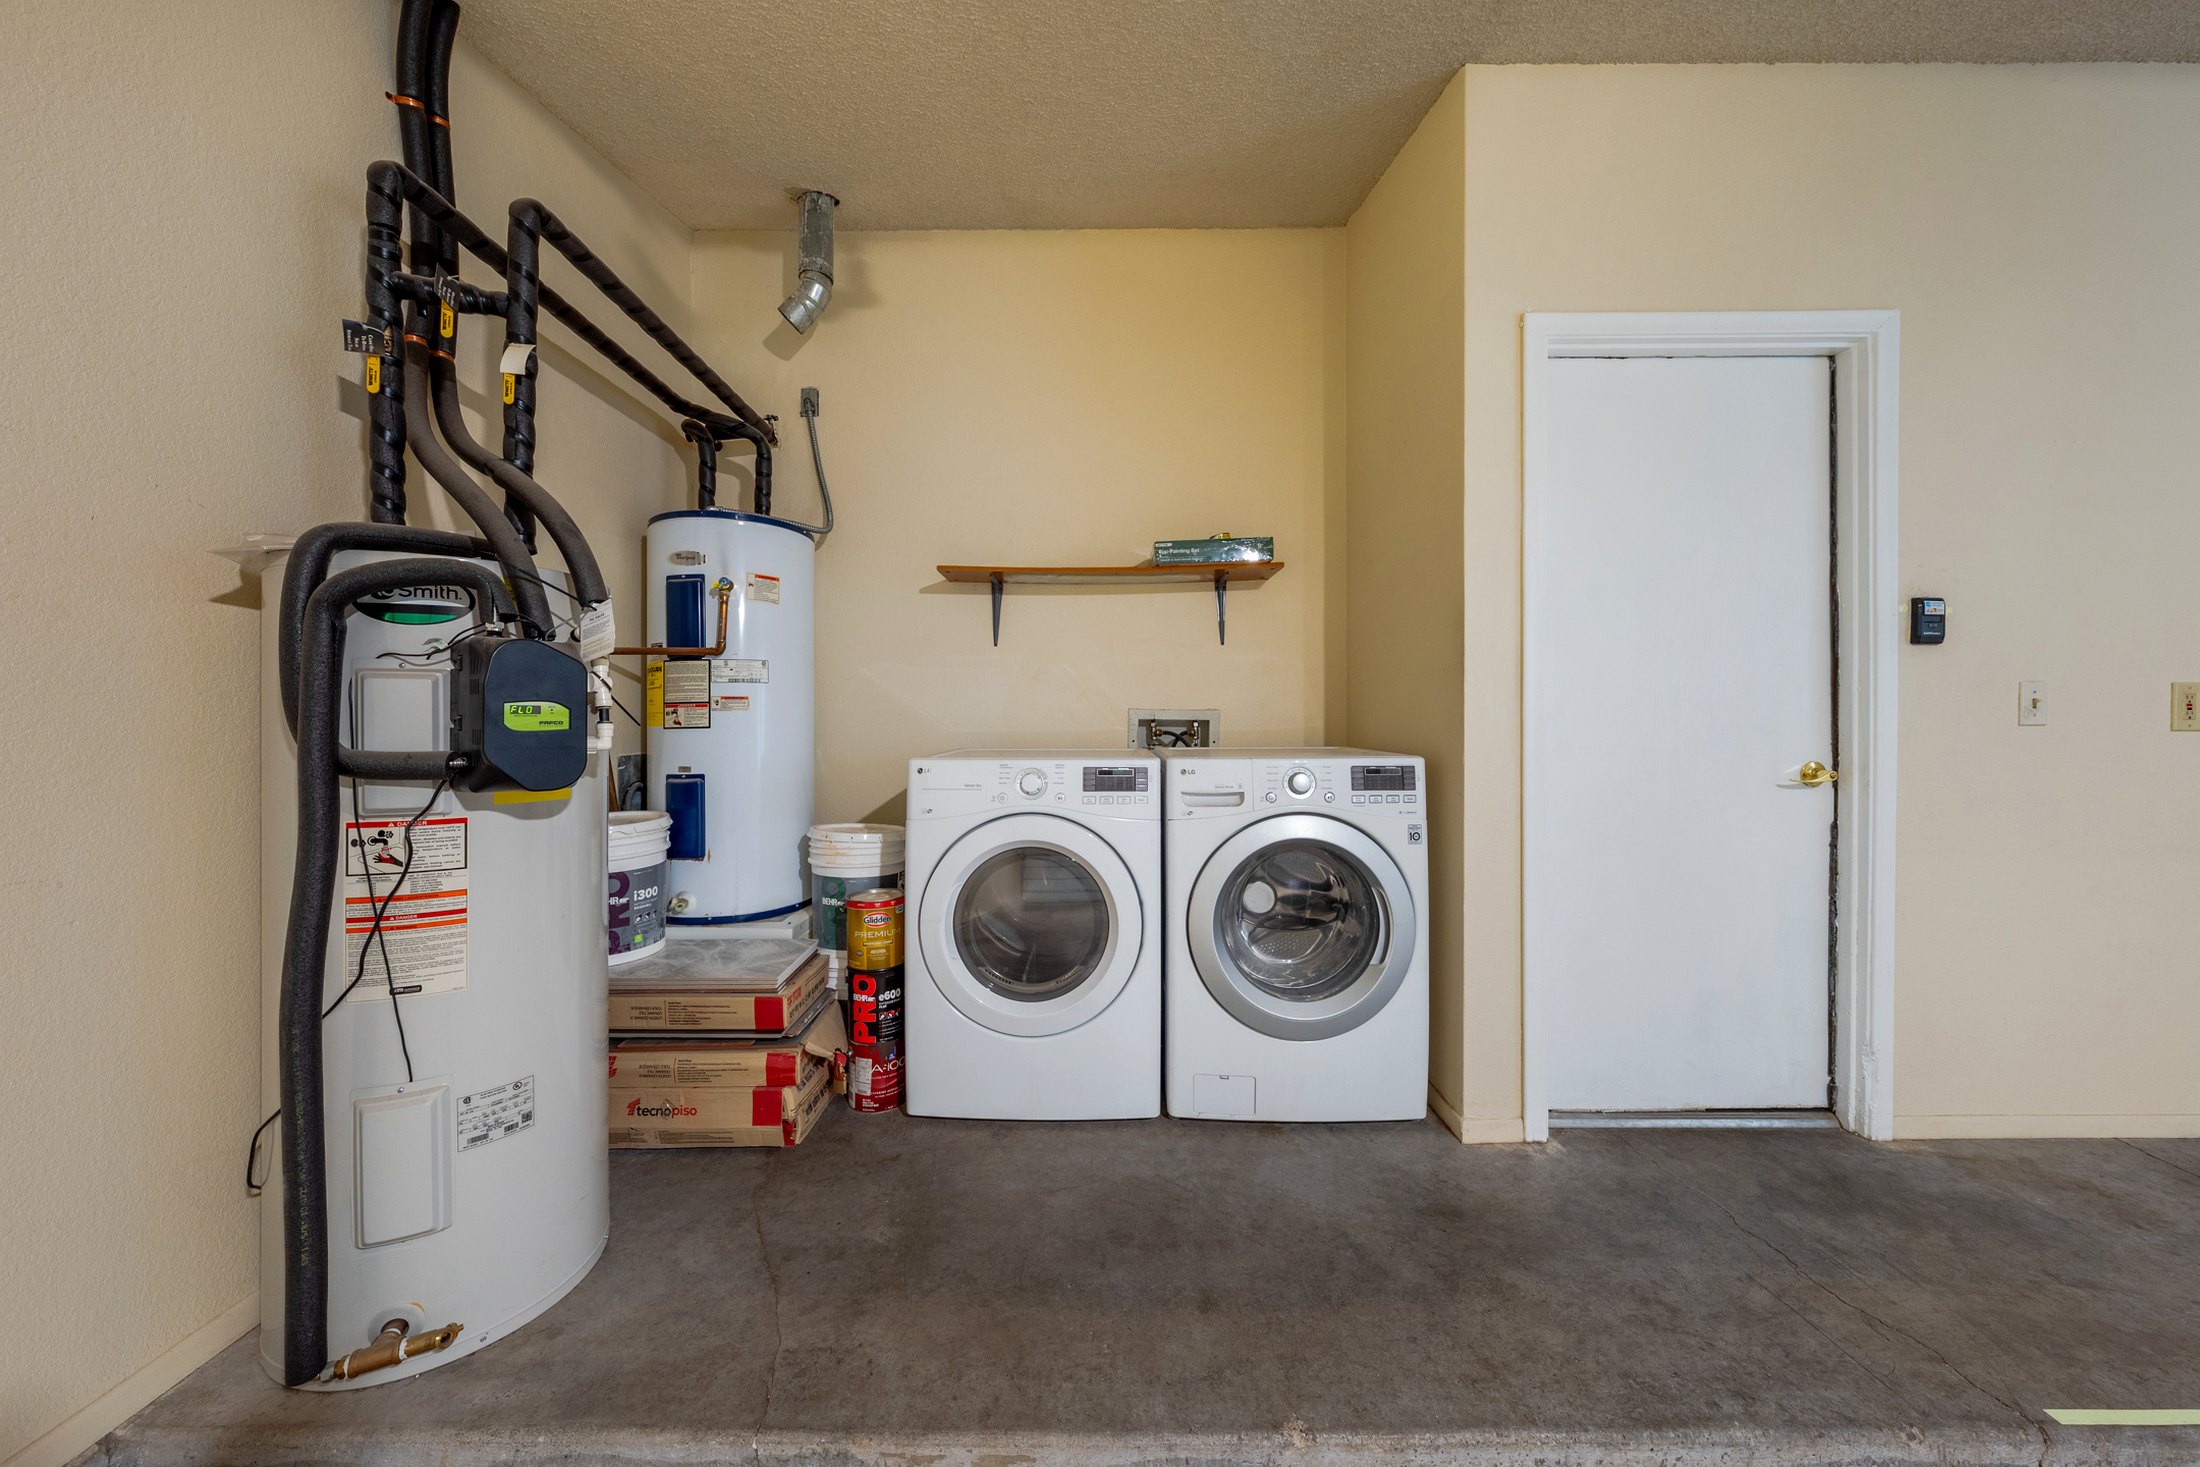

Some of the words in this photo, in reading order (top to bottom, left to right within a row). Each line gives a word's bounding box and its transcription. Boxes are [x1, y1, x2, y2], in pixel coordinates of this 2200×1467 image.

[634, 886, 658, 902] i300
[822, 896, 838, 906] BEHR
[864, 914, 892, 924] Glidden
[854, 928, 901, 938] PREMIUM
[878, 988, 901, 1002] e600
[853, 974, 876, 1044] PRO
[636, 1104, 698, 1118] tecnopiso
